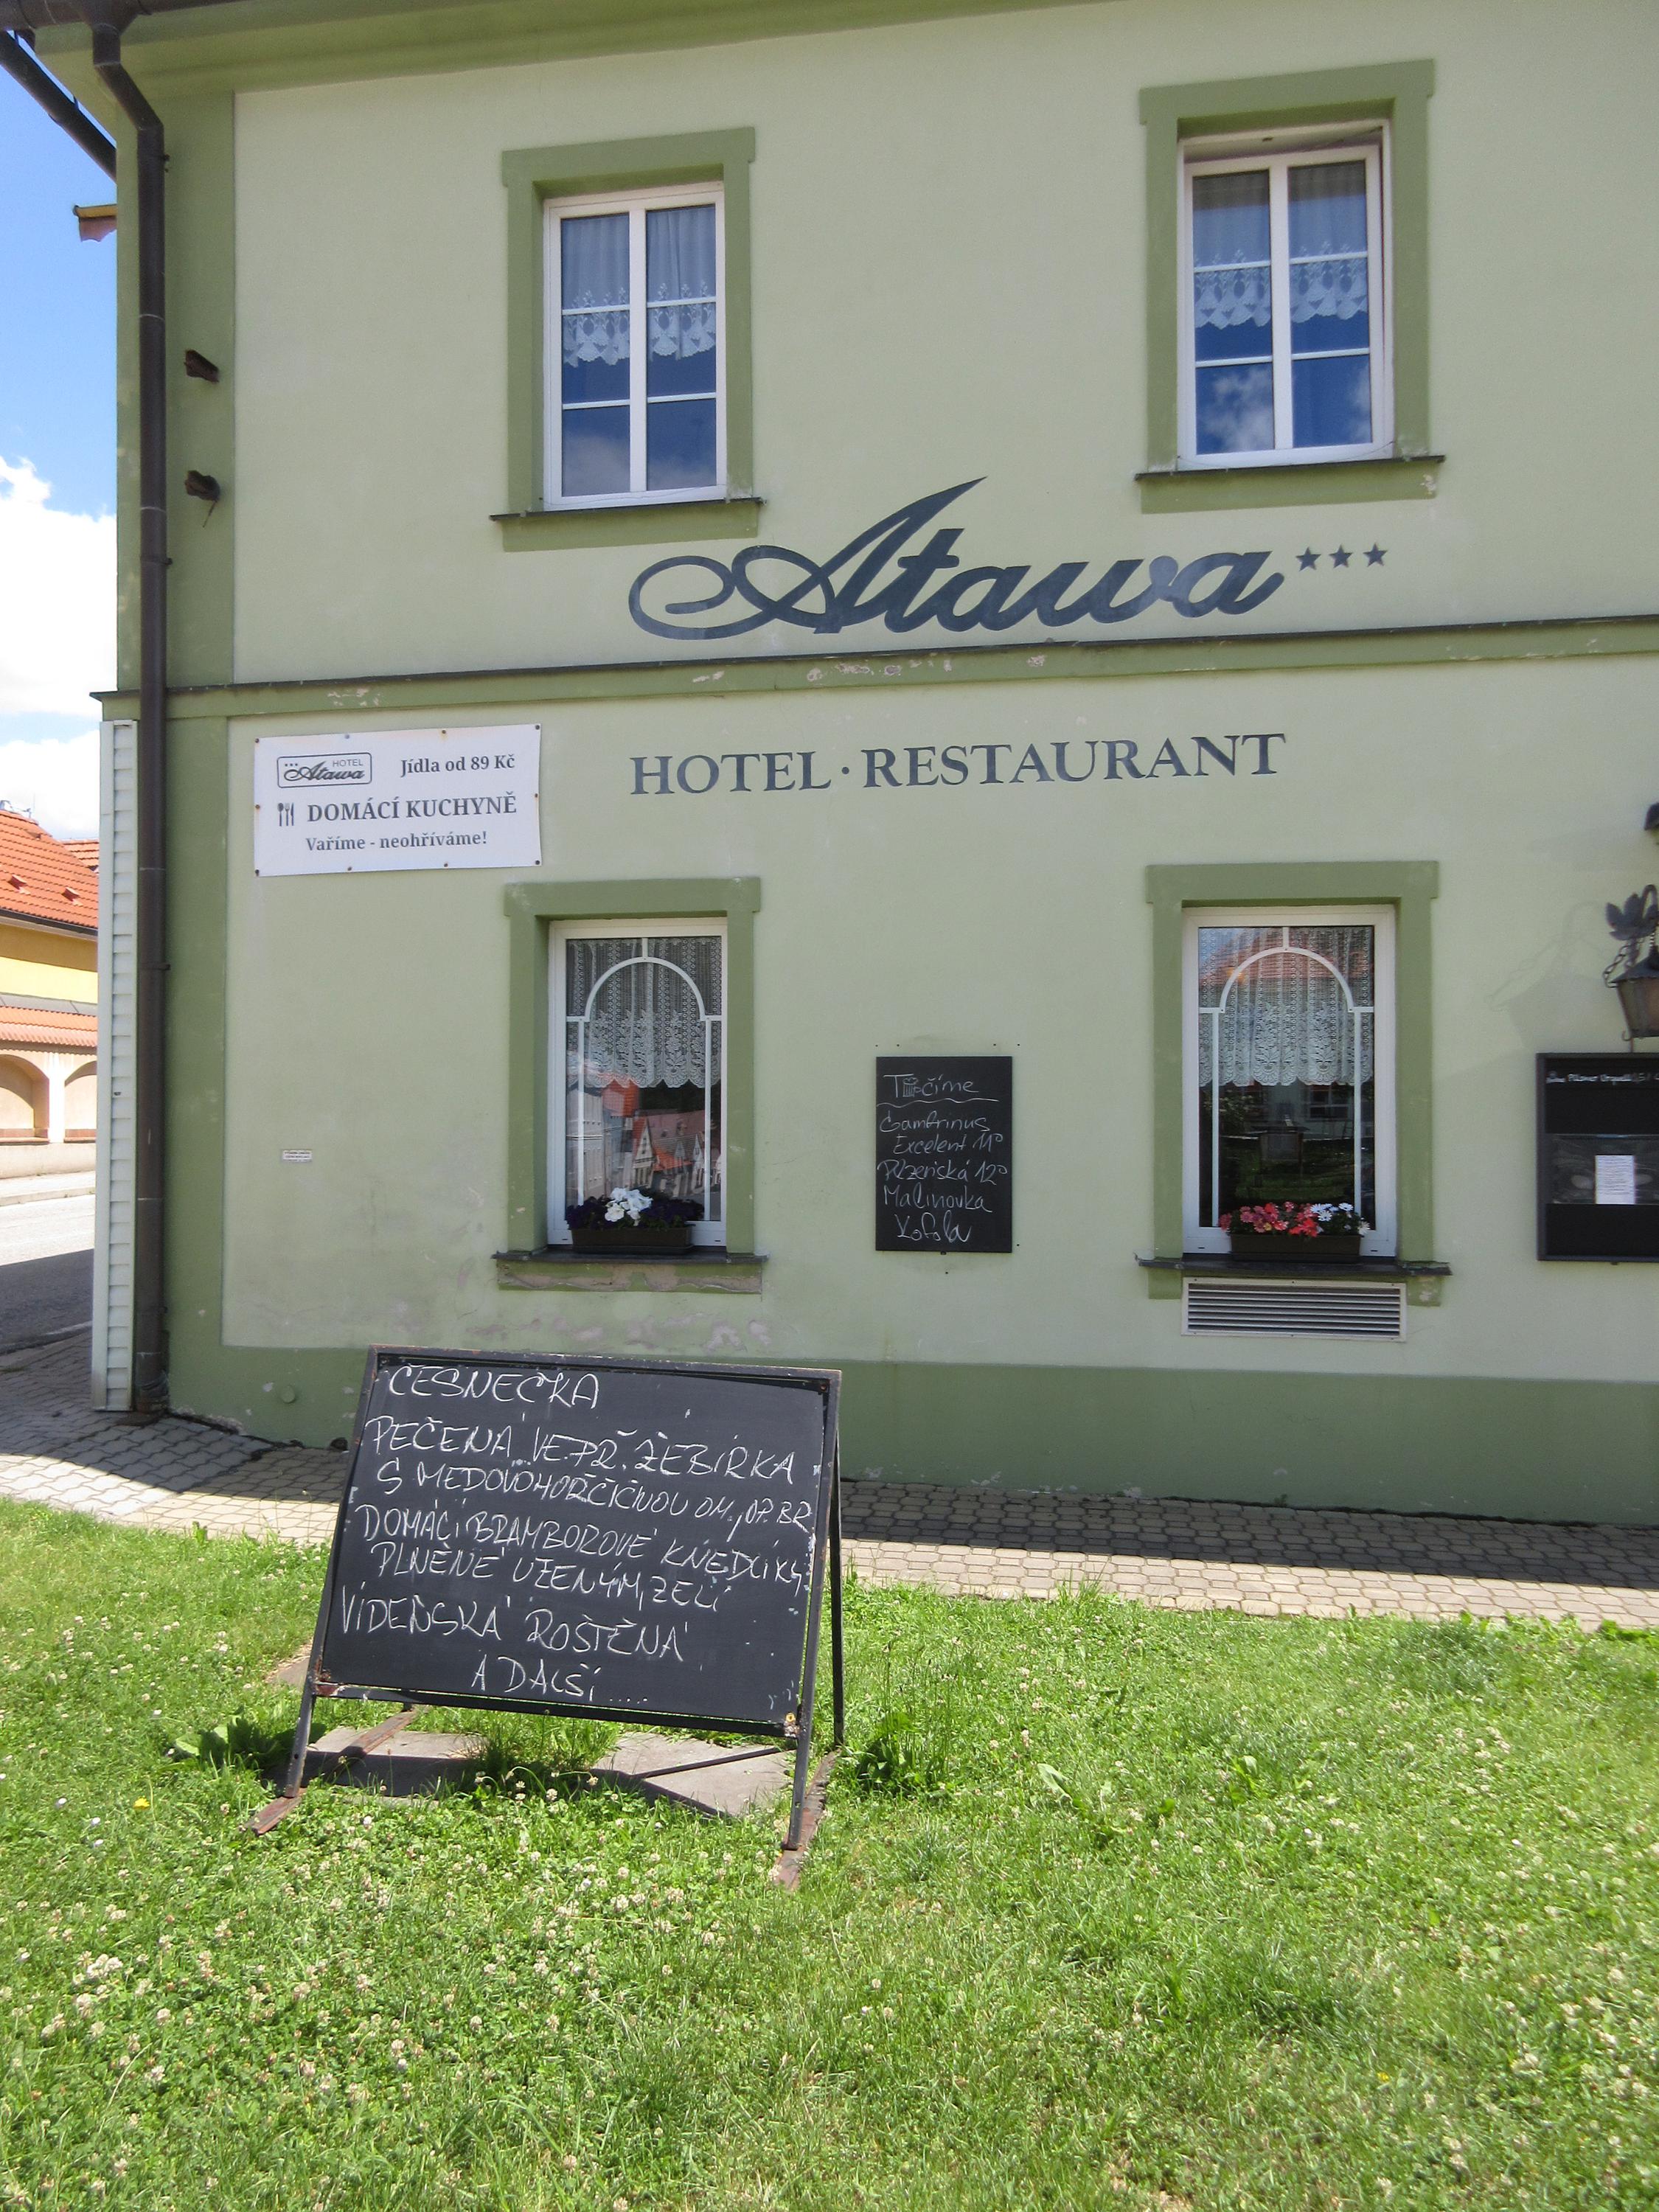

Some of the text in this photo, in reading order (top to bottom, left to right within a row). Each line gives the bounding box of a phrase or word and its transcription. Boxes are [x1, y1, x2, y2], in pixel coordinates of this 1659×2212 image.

[628, 476, 1284, 640] Atawa
[284, 761, 366, 782] Atawa
[333, 759, 364, 768] HOTEL
[400, 754, 515, 778] Jídla od 89 Kč
[307, 791, 517, 822] DOMÁCÍ KUCHYNĚ
[305, 835, 366, 851] Vaříme
[380, 831, 487, 849] neohříváme!
[892, 1134, 967, 1155] Excelent
[884, 1182, 993, 1213] Malinovka
[894, 1209, 975, 1243] Kofola
[389, 1363, 599, 1410] ČESNEČKA
[365, 1411, 526, 1457] PEČENÁ
[377, 1457, 402, 1495] S
[465, 1511, 658, 1558] BRAMBOROVÉ
[370, 1540, 506, 1578] PLNĚNÉ
[342, 1581, 689, 1663] VÍDEŇSKÁ ROŠTĚNÁ
[470, 1654, 487, 1691] A
[497, 1655, 602, 1701] DALŠÍ
